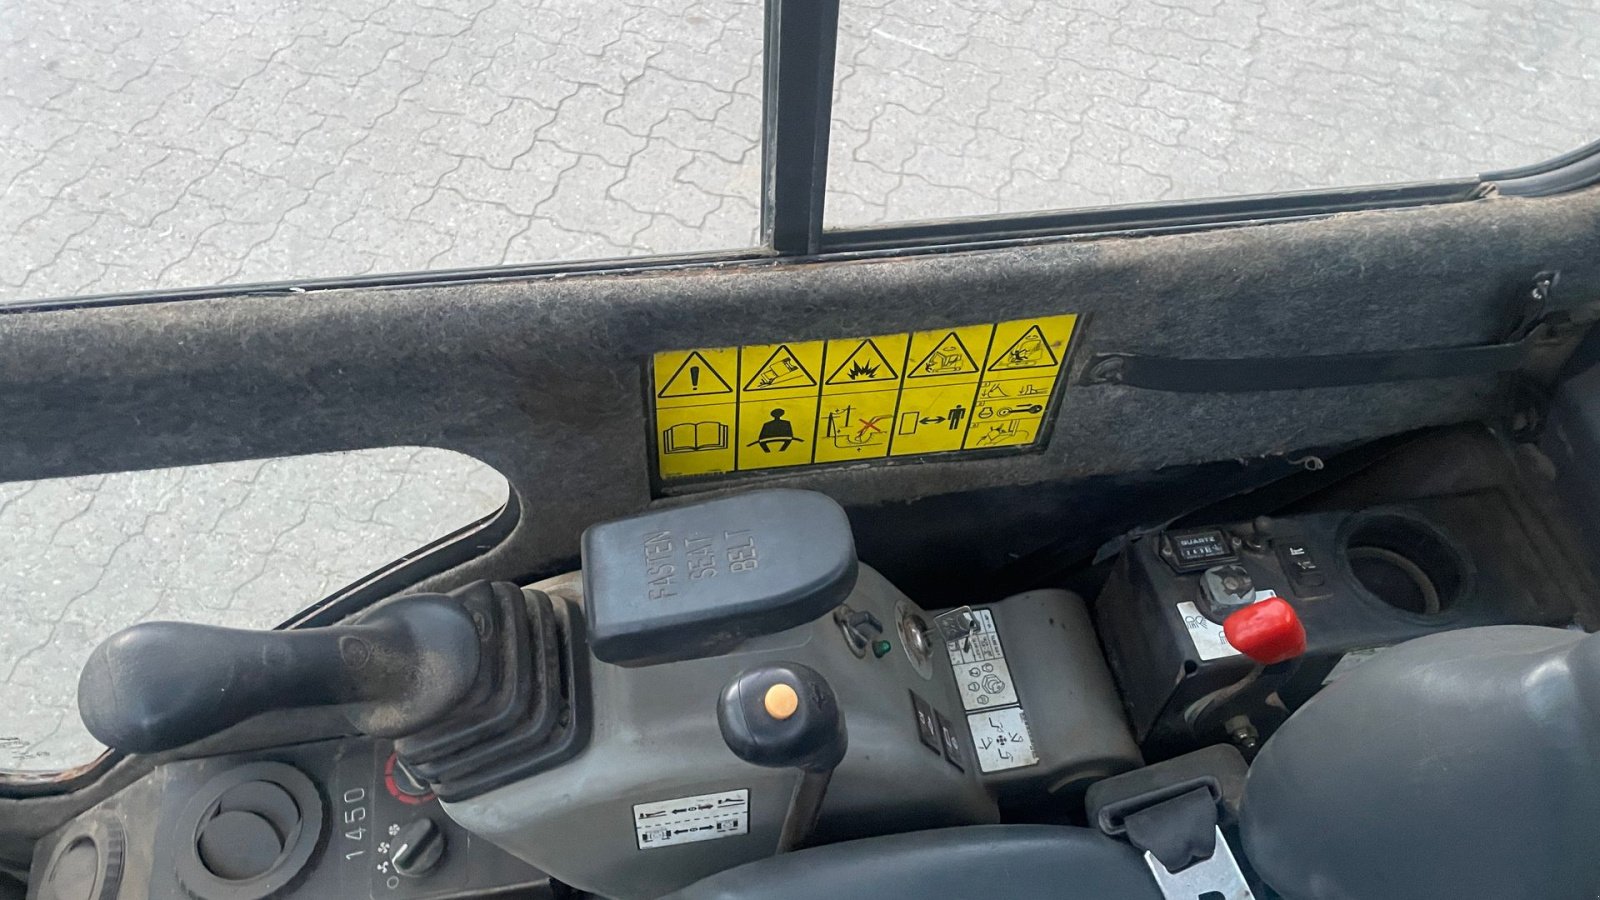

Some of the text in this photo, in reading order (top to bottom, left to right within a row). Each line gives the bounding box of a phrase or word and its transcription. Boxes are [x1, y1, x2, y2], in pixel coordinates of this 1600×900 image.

[643, 530, 677, 600] FASTEN
[684, 537, 718, 580] SEAT
[724, 529, 758, 573] BELT
[344, 788, 366, 860] 1450
